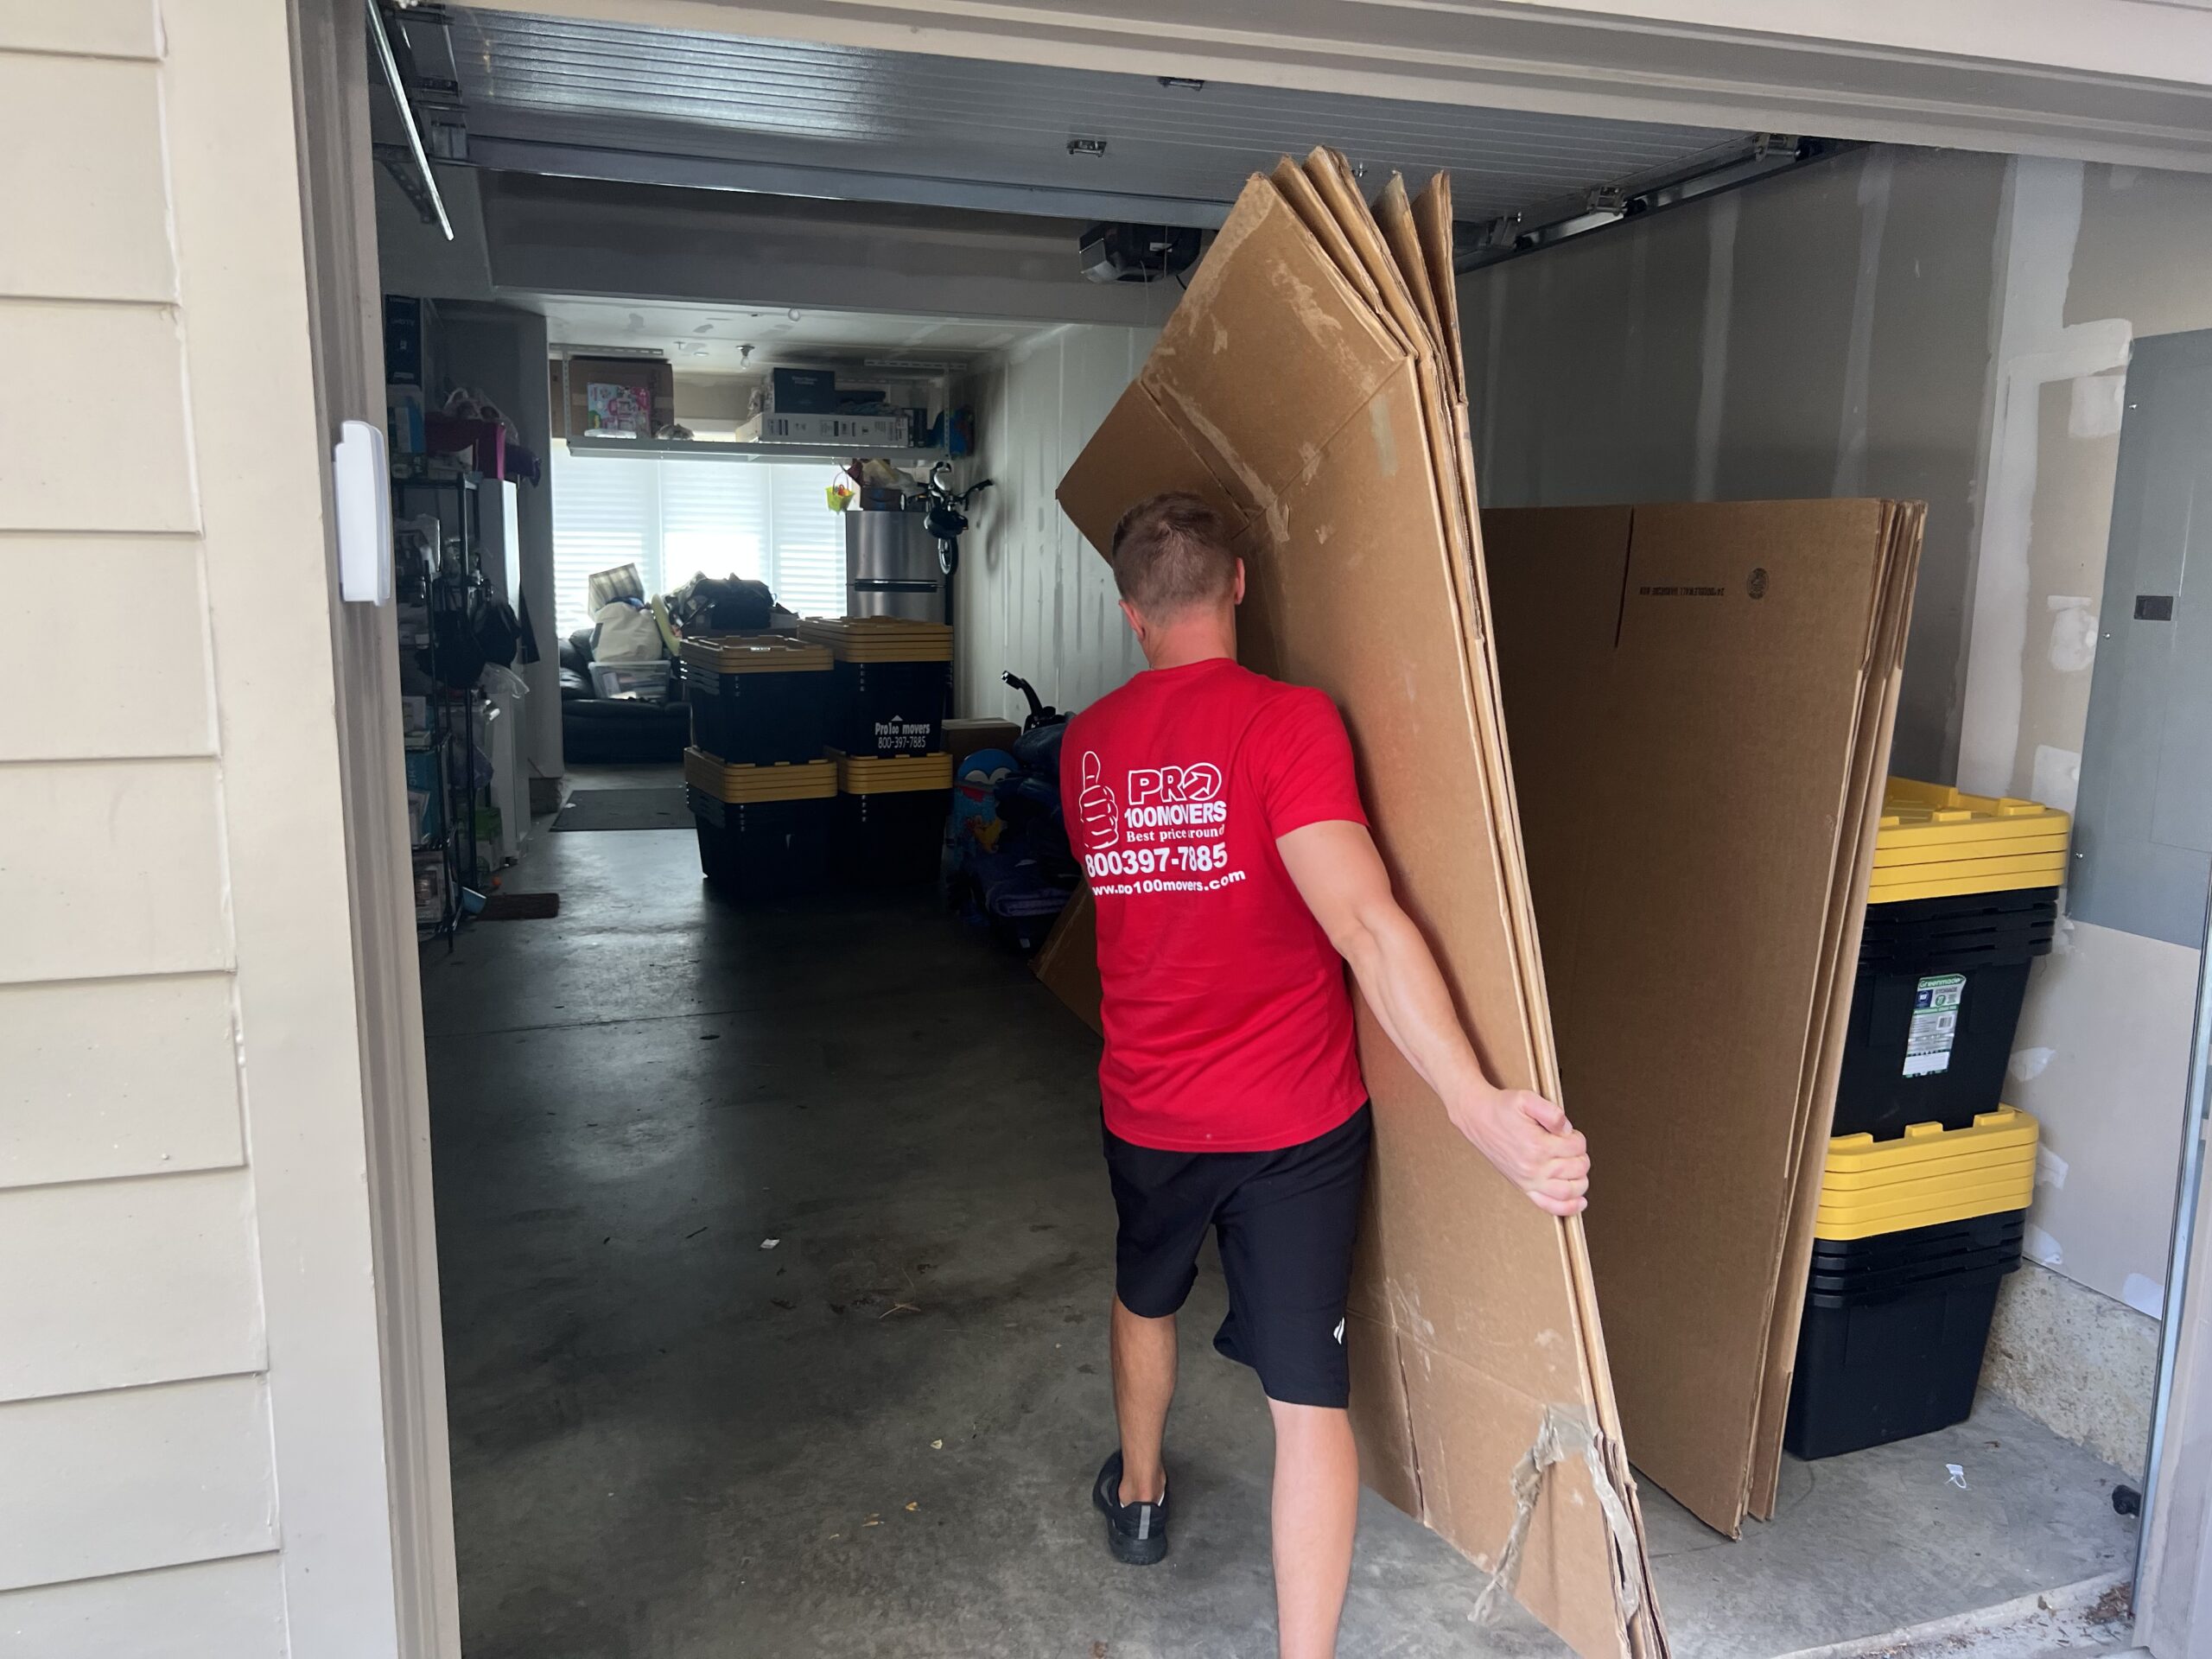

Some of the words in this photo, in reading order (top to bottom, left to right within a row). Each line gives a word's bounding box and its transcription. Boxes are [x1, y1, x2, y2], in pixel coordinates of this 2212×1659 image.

[902, 723, 931, 734] movers
[878, 735, 926, 749] 800-397-7885
[1124, 800, 1227, 829] 100MOVERS
[1126, 830, 1155, 842] Best
[1159, 828, 1187, 842] price
